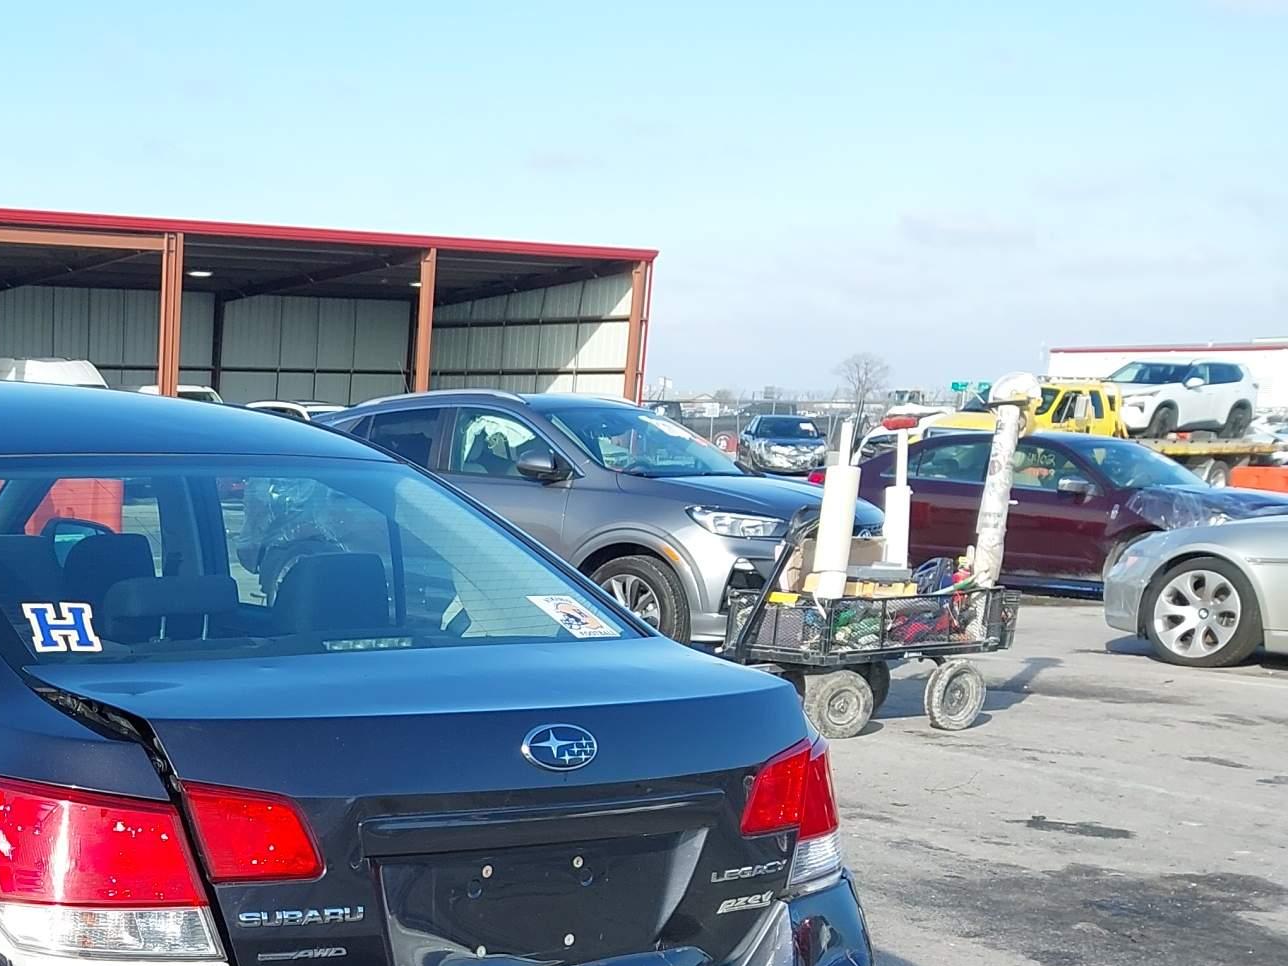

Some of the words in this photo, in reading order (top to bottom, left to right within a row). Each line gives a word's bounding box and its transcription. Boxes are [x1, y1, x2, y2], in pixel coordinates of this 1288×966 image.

[22, 602, 102, 652] H
[711, 859, 788, 883] LEGACY
[238, 906, 364, 928] SUBARU
[292, 947, 347, 960] AWD
